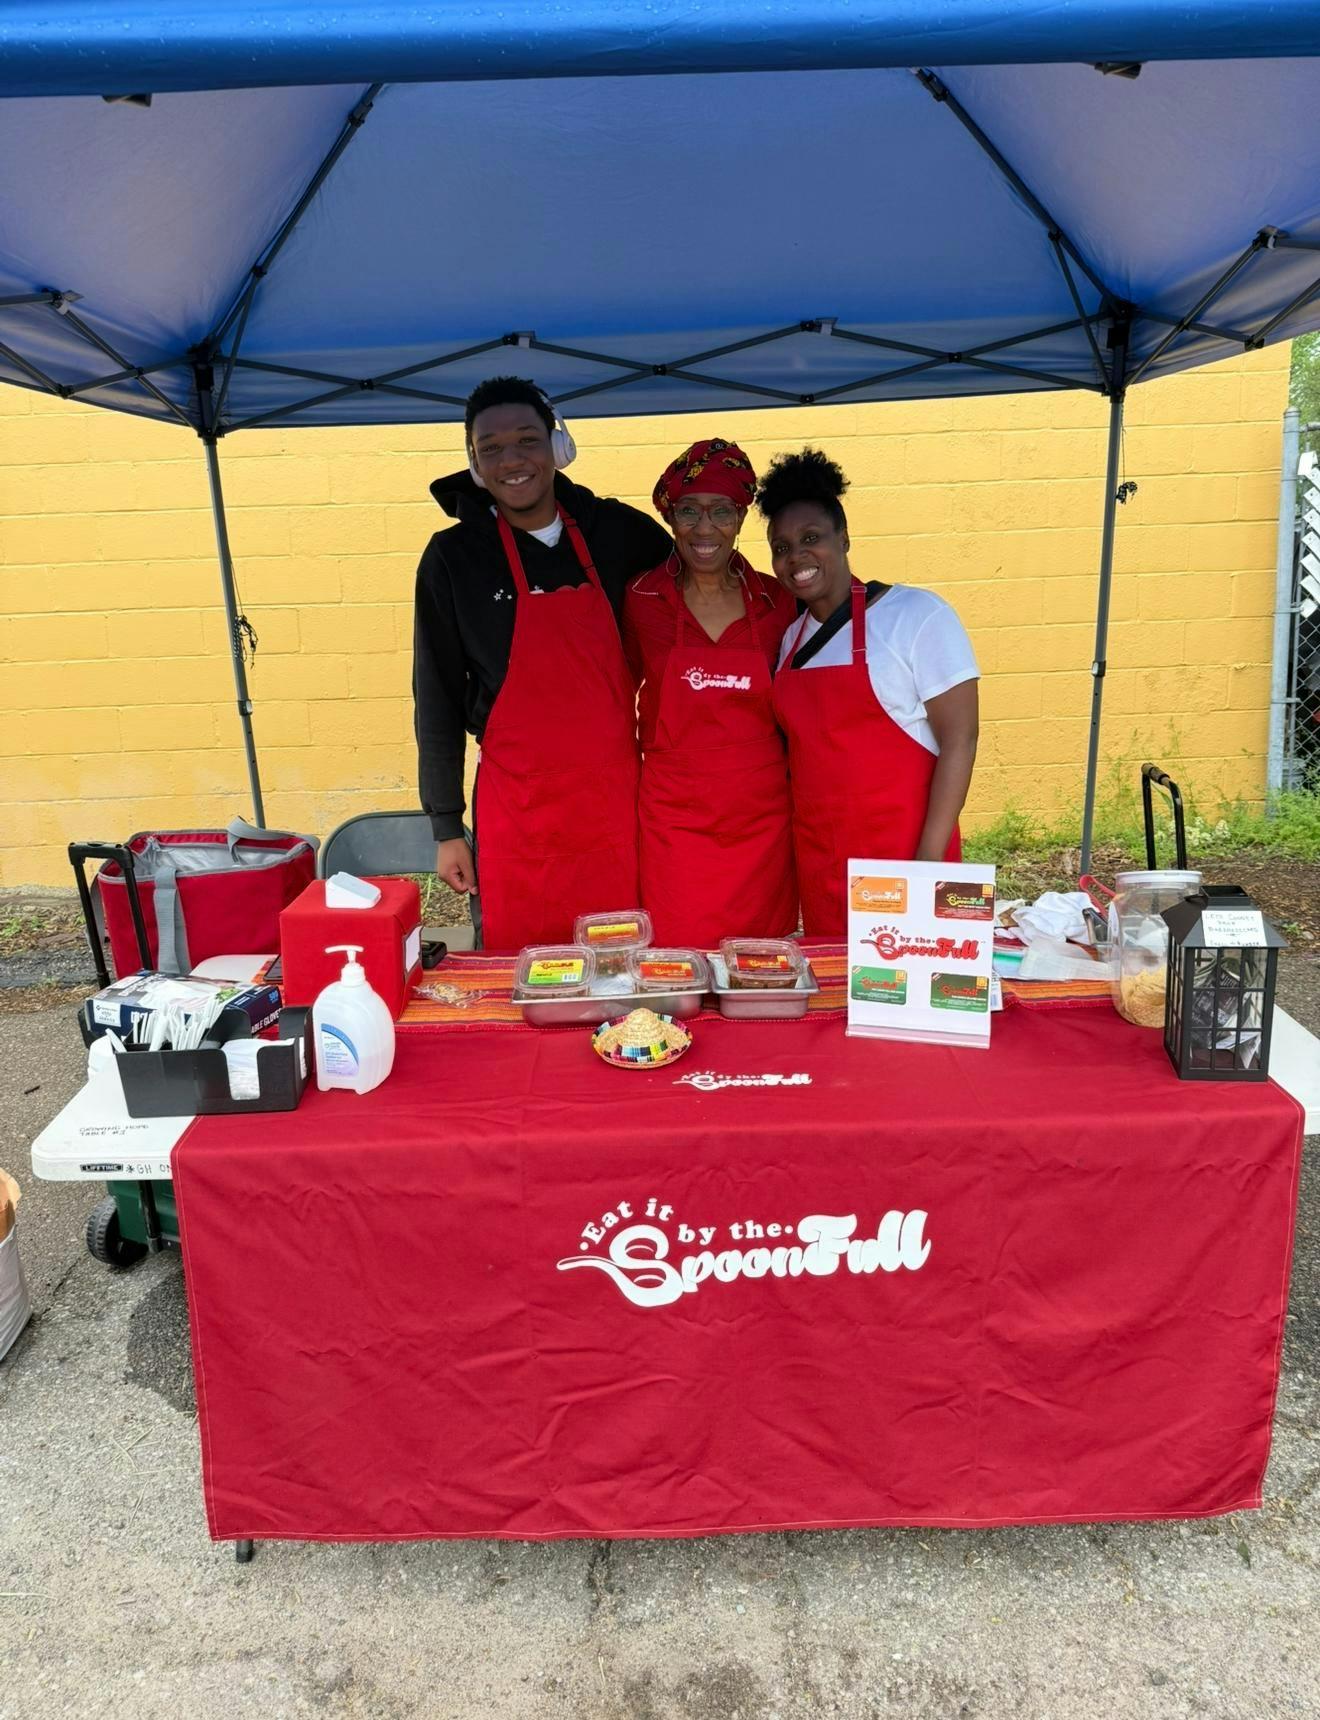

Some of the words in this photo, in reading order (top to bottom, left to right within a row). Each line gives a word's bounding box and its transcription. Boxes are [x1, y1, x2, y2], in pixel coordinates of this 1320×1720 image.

[871, 925, 888, 935] Eat
[890, 926, 900, 935] it
[900, 935, 912, 944] by
[915, 936, 931, 944] the
[860, 933, 980, 961] SpoonFull
[263, 1007, 281, 1027] GLOVE
[672, 1073, 812, 1091] SpoonFull
[582, 1199, 634, 1245] Eat
[645, 1198, 674, 1222] it
[677, 1223, 717, 1245] by
[729, 1220, 783, 1239] the
[556, 1209, 932, 1307] SpoonFull
